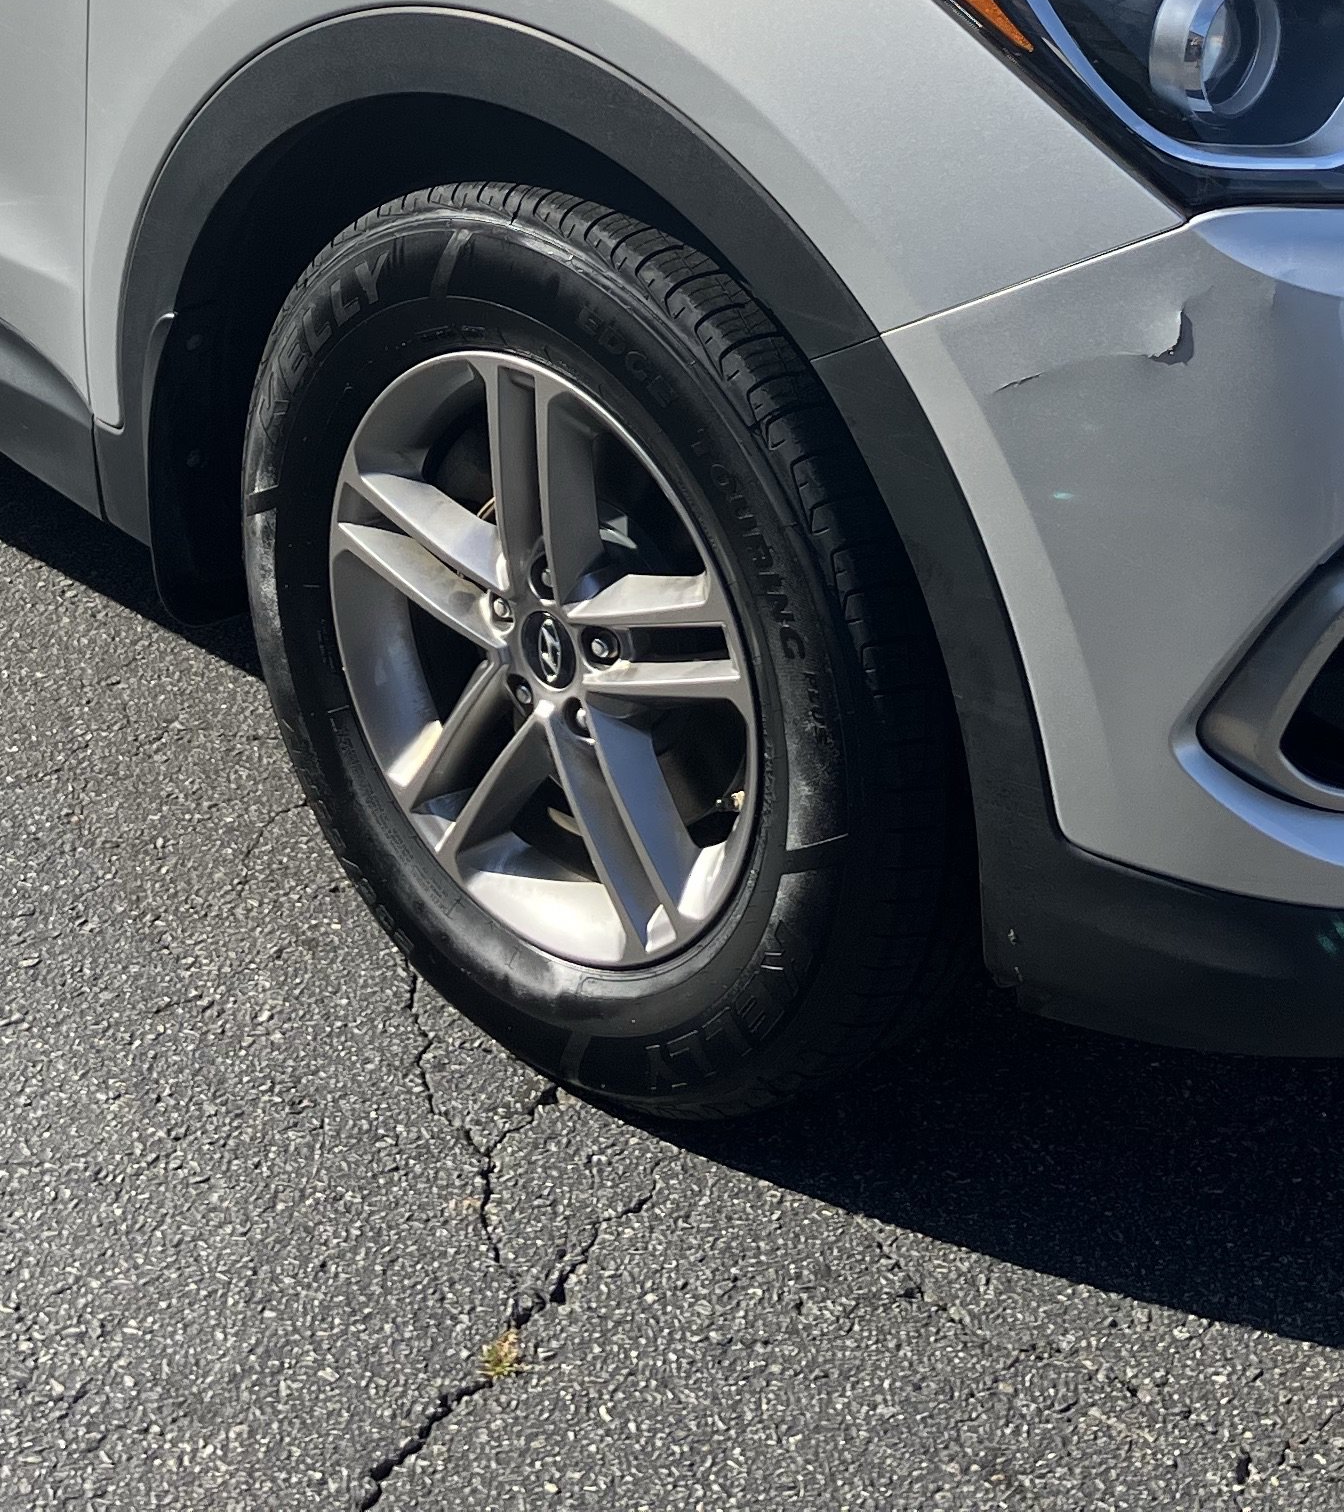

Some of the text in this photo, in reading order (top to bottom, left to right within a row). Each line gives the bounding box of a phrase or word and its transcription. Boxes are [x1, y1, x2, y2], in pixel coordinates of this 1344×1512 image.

[258, 249, 390, 445] KELLY
[577, 303, 675, 410] EDGE
[689, 426, 806, 663] TOURING
[645, 919, 806, 1091] KELLY
